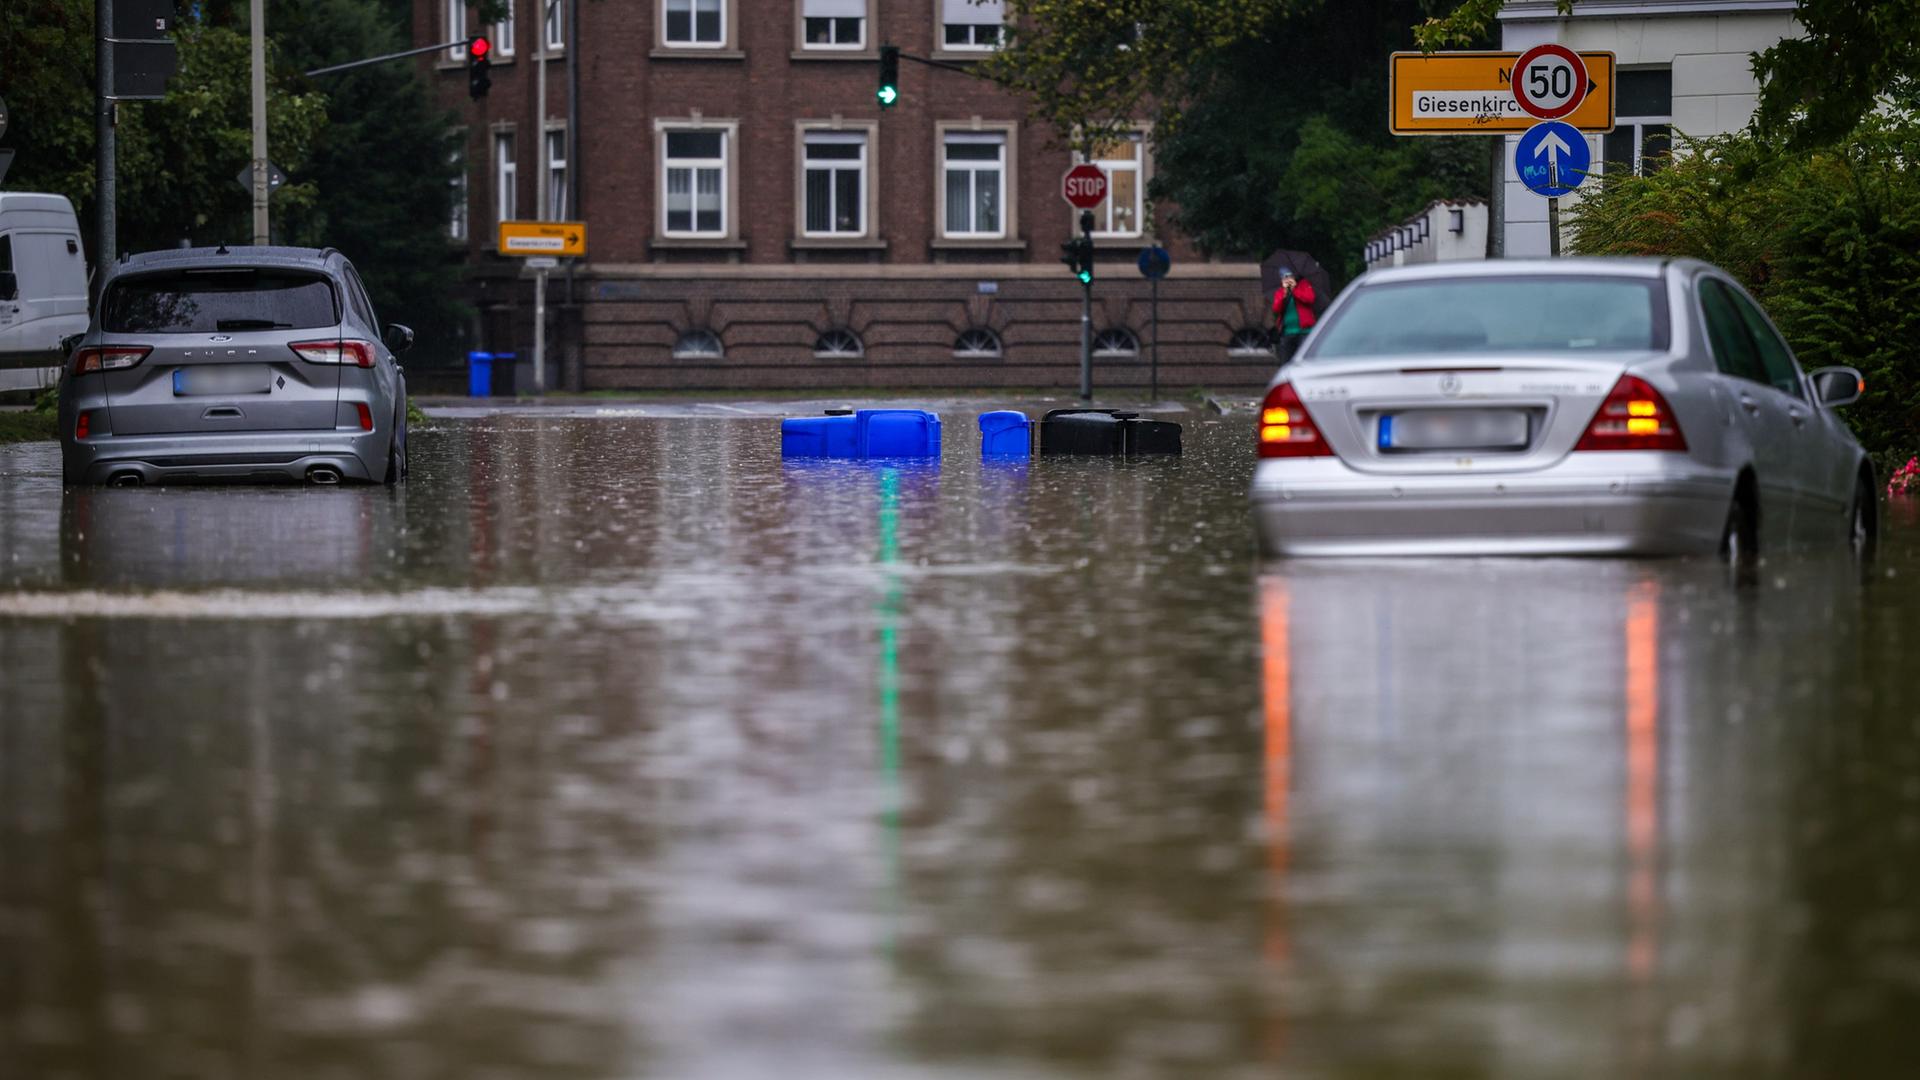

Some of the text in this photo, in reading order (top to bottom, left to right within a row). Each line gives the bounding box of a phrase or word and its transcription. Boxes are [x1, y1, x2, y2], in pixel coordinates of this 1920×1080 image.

[1530, 65, 1571, 99] 50
[1418, 96, 1521, 112] Giesenkirc
[1067, 177, 1105, 197] STOP
